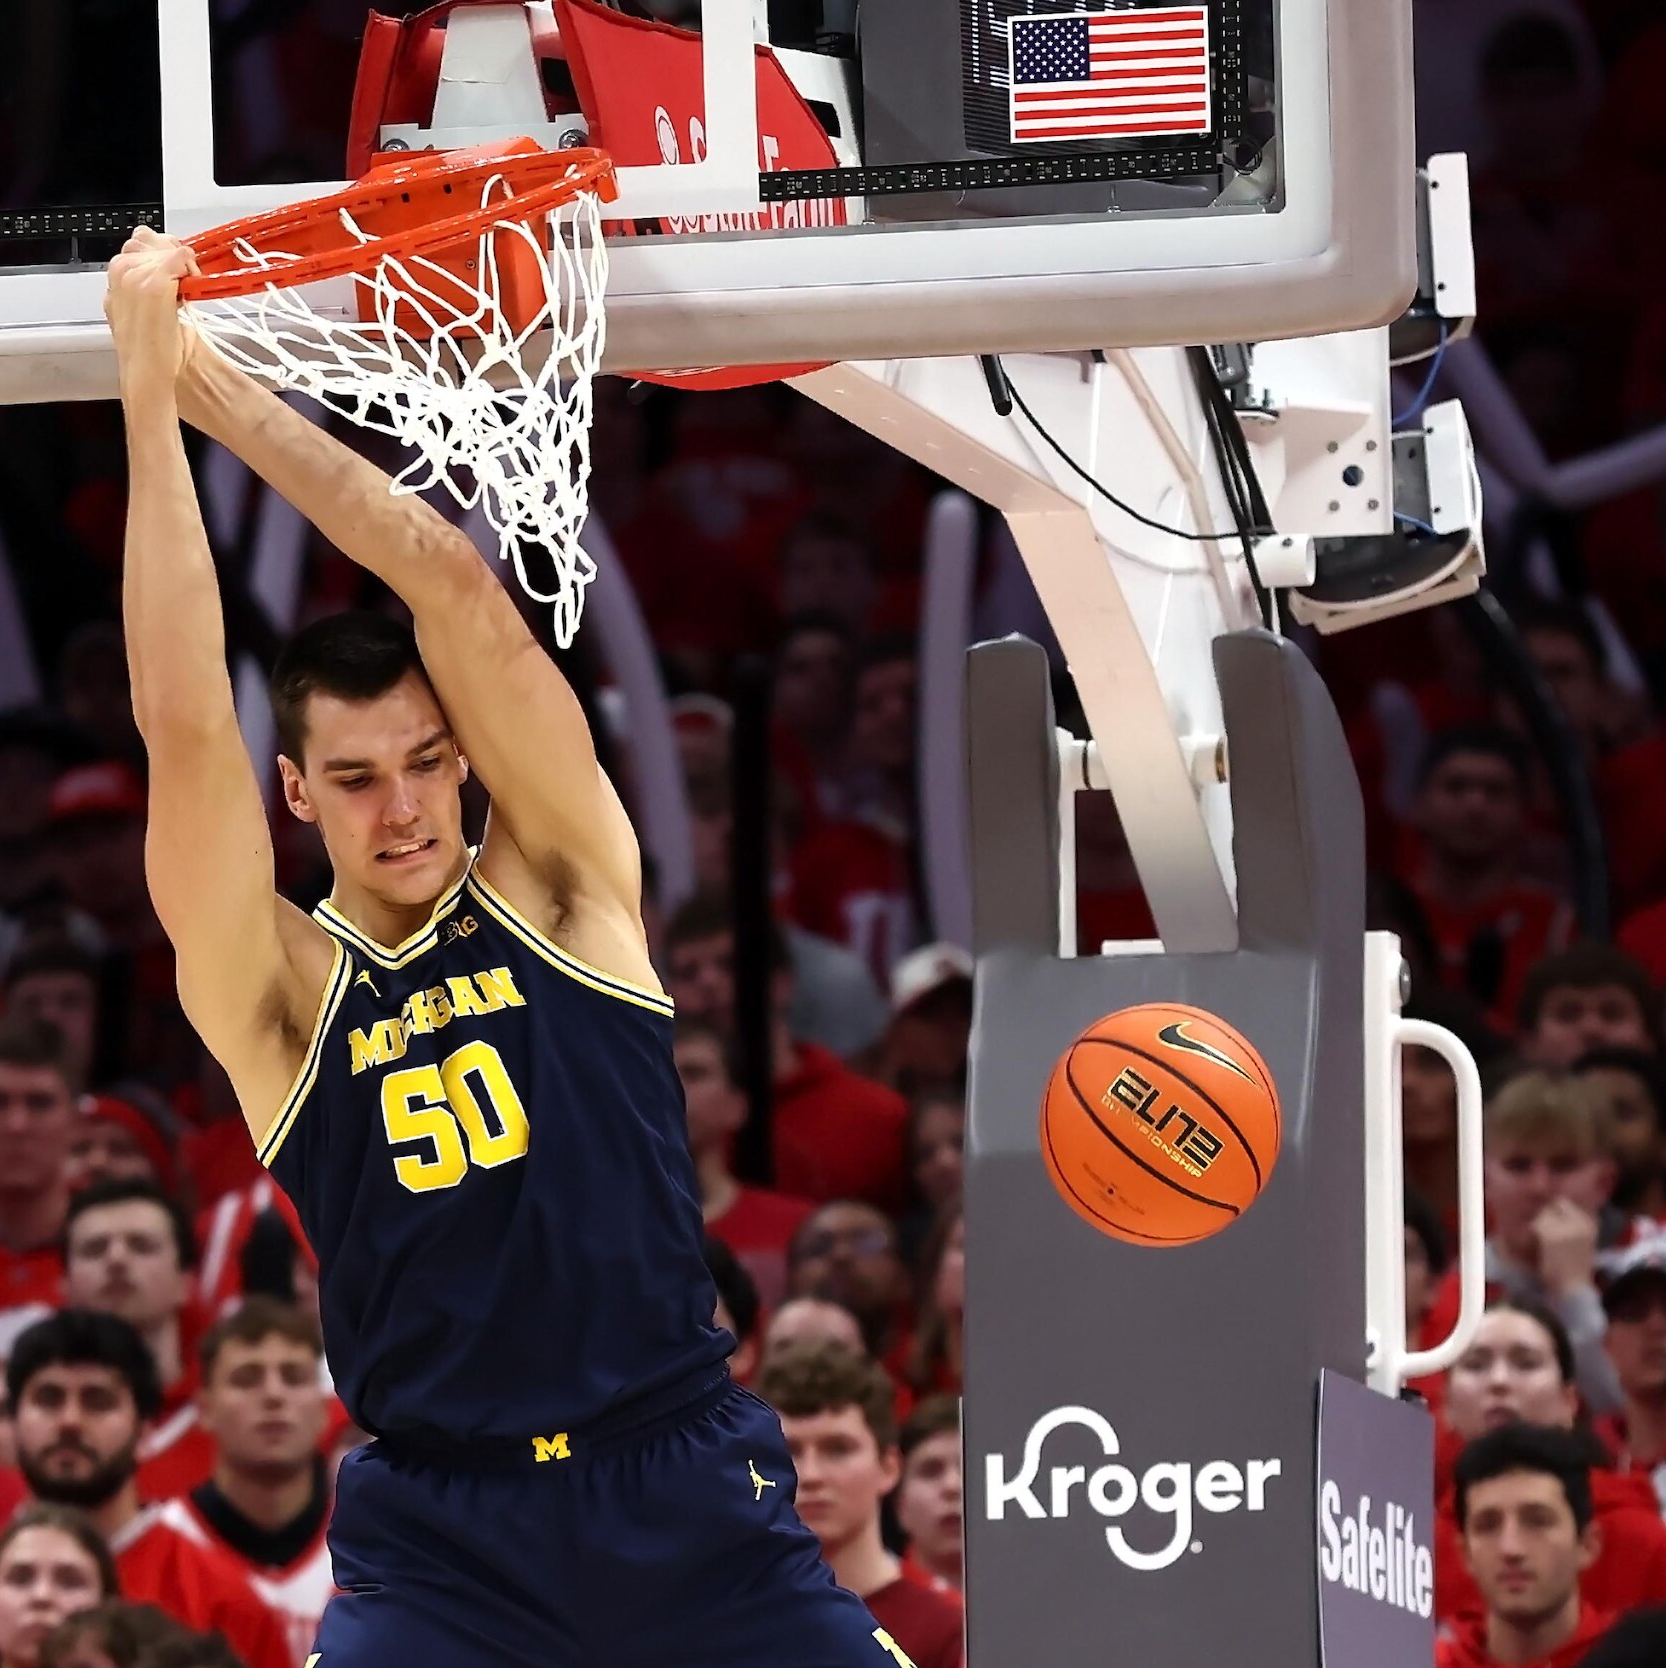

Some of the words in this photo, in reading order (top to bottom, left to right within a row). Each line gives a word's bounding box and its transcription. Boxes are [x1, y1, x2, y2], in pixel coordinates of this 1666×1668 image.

[348, 967, 528, 1076] MIHGAN
[381, 1040, 531, 1194] 50
[1101, 1095, 1203, 1178] CHPIONSHIP
[1108, 1066, 1225, 1170] ELITE
[532, 1432, 572, 1462] M
[985, 1405, 1282, 1570] Kroger
[1321, 1479, 1433, 1619] Safelite
